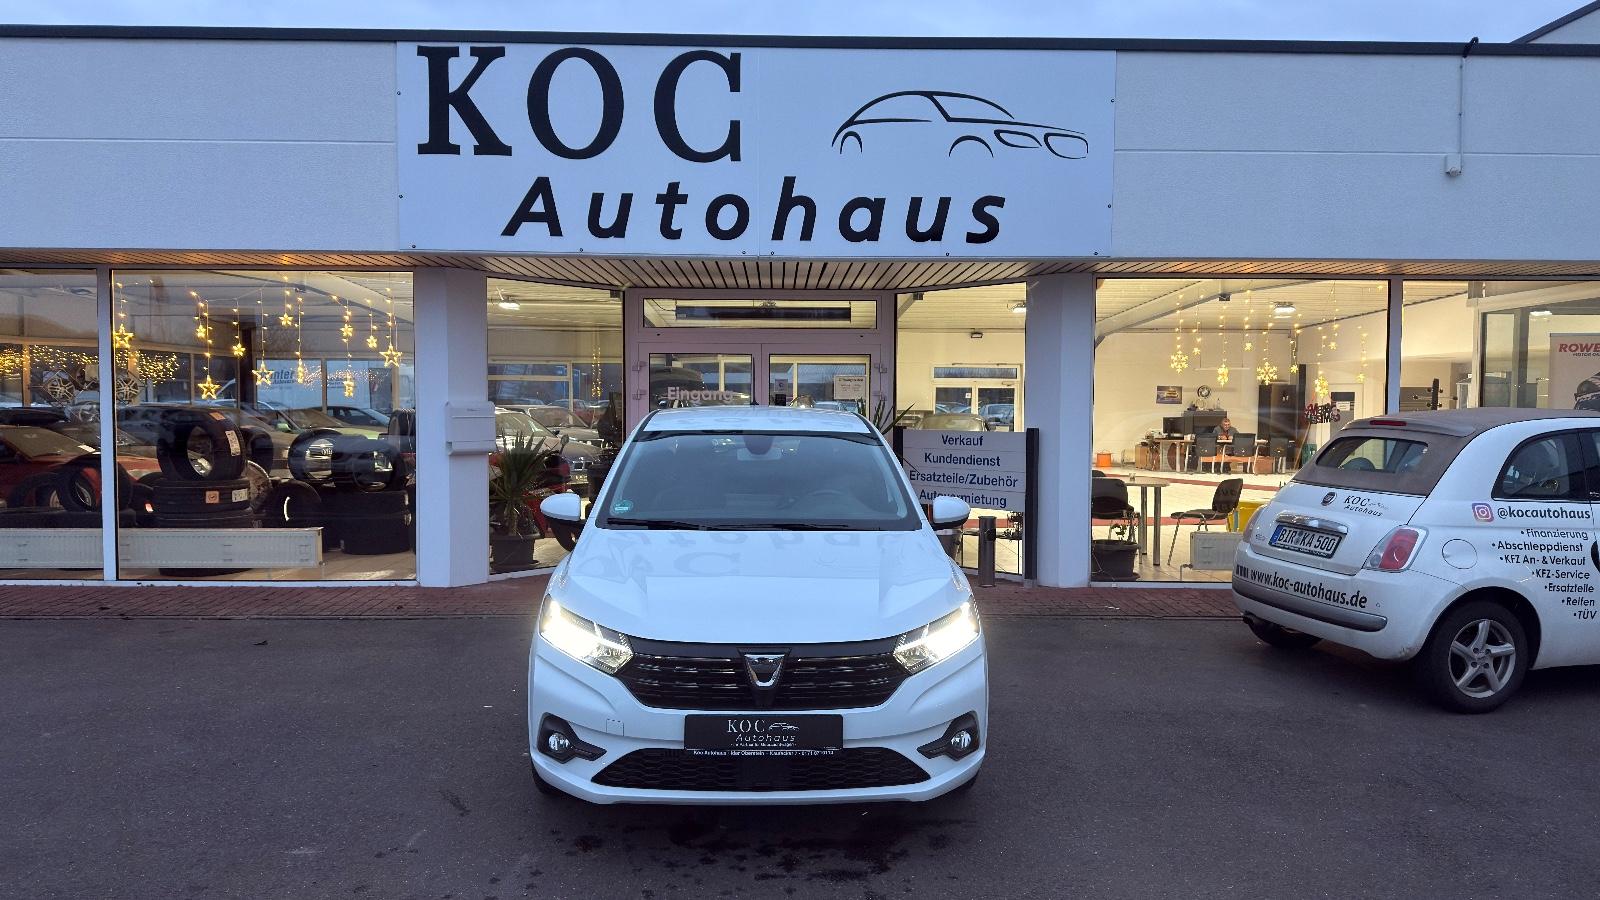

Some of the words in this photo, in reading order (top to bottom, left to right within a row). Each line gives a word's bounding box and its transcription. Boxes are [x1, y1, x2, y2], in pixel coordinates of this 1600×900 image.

[416, 45, 742, 163] KOC
[500, 176, 1006, 243] Autohaus
[1558, 343, 1600, 353] ROWE
[667, 386, 734, 404] Eingang
[941, 434, 984, 447] Verkauf
[924, 452, 1001, 467] Kundendienst
[909, 469, 1018, 488] Ersatzteile/Zubehör
[919, 489, 1007, 508] Autmietung
[1344, 495, 1370, 507] KOC
[1344, 505, 1383, 517] Autohaus
[1497, 506, 1591, 519] @kocautohaus
[1277, 528, 1294, 544] BIR
[1299, 532, 1314, 548] KA
[1314, 535, 1336, 552] 500
[1526, 529, 1589, 541] Finanzierung
[1497, 541, 1584, 553] Abschleppdienst
[1504, 555, 1521, 564] KFZ
[1523, 555, 1540, 565] An-
[1541, 555, 1548, 565] &
[1550, 556, 1586, 566] Verkauf
[1535, 569, 1591, 579] KFZ-Service
[1250, 569, 1368, 609] www.koc-autohaus.de
[1548, 583, 1594, 593] Ersatzteile
[1566, 597, 1595, 607] Reifen
[1577, 608, 1597, 620] TÜV
[727, 719, 766, 733] KOC
[735, 733, 796, 742] Autohaus
